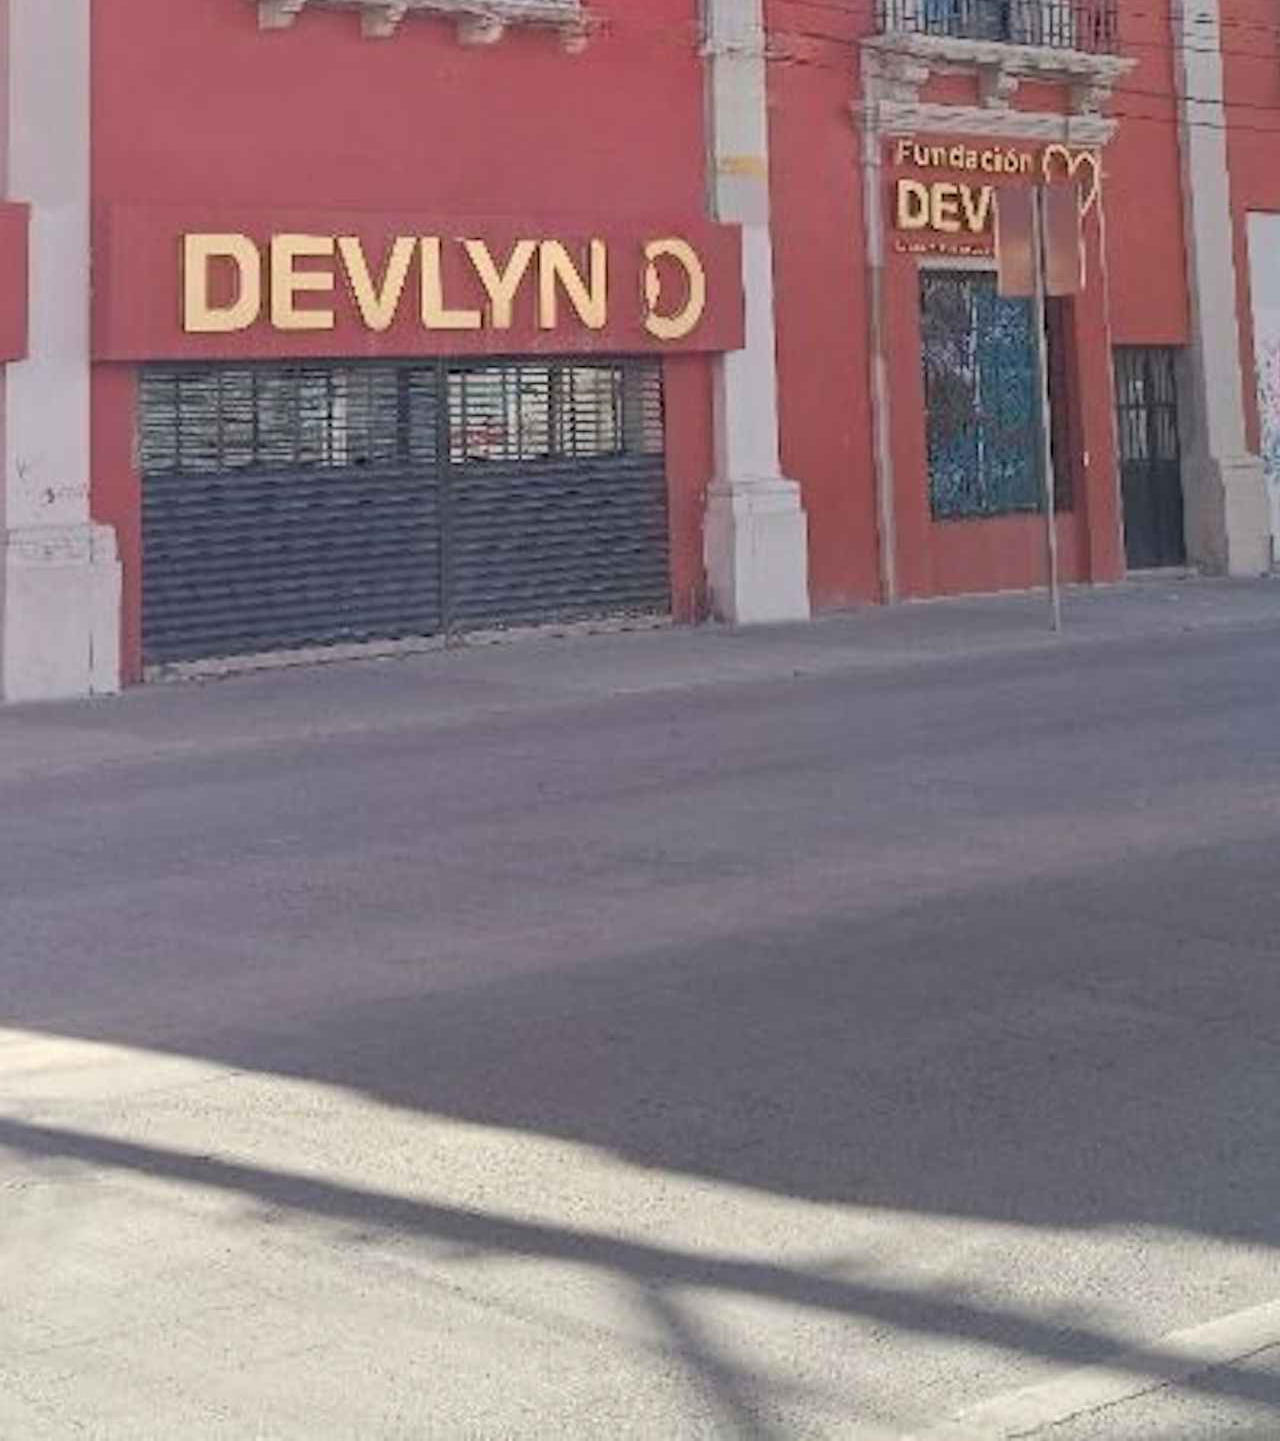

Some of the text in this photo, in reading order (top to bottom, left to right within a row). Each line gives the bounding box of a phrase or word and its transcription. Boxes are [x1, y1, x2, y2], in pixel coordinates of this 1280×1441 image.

[896, 138, 1033, 174] Fundación
[896, 178, 992, 234] DEV
[181, 232, 608, 333] DEVLYN
